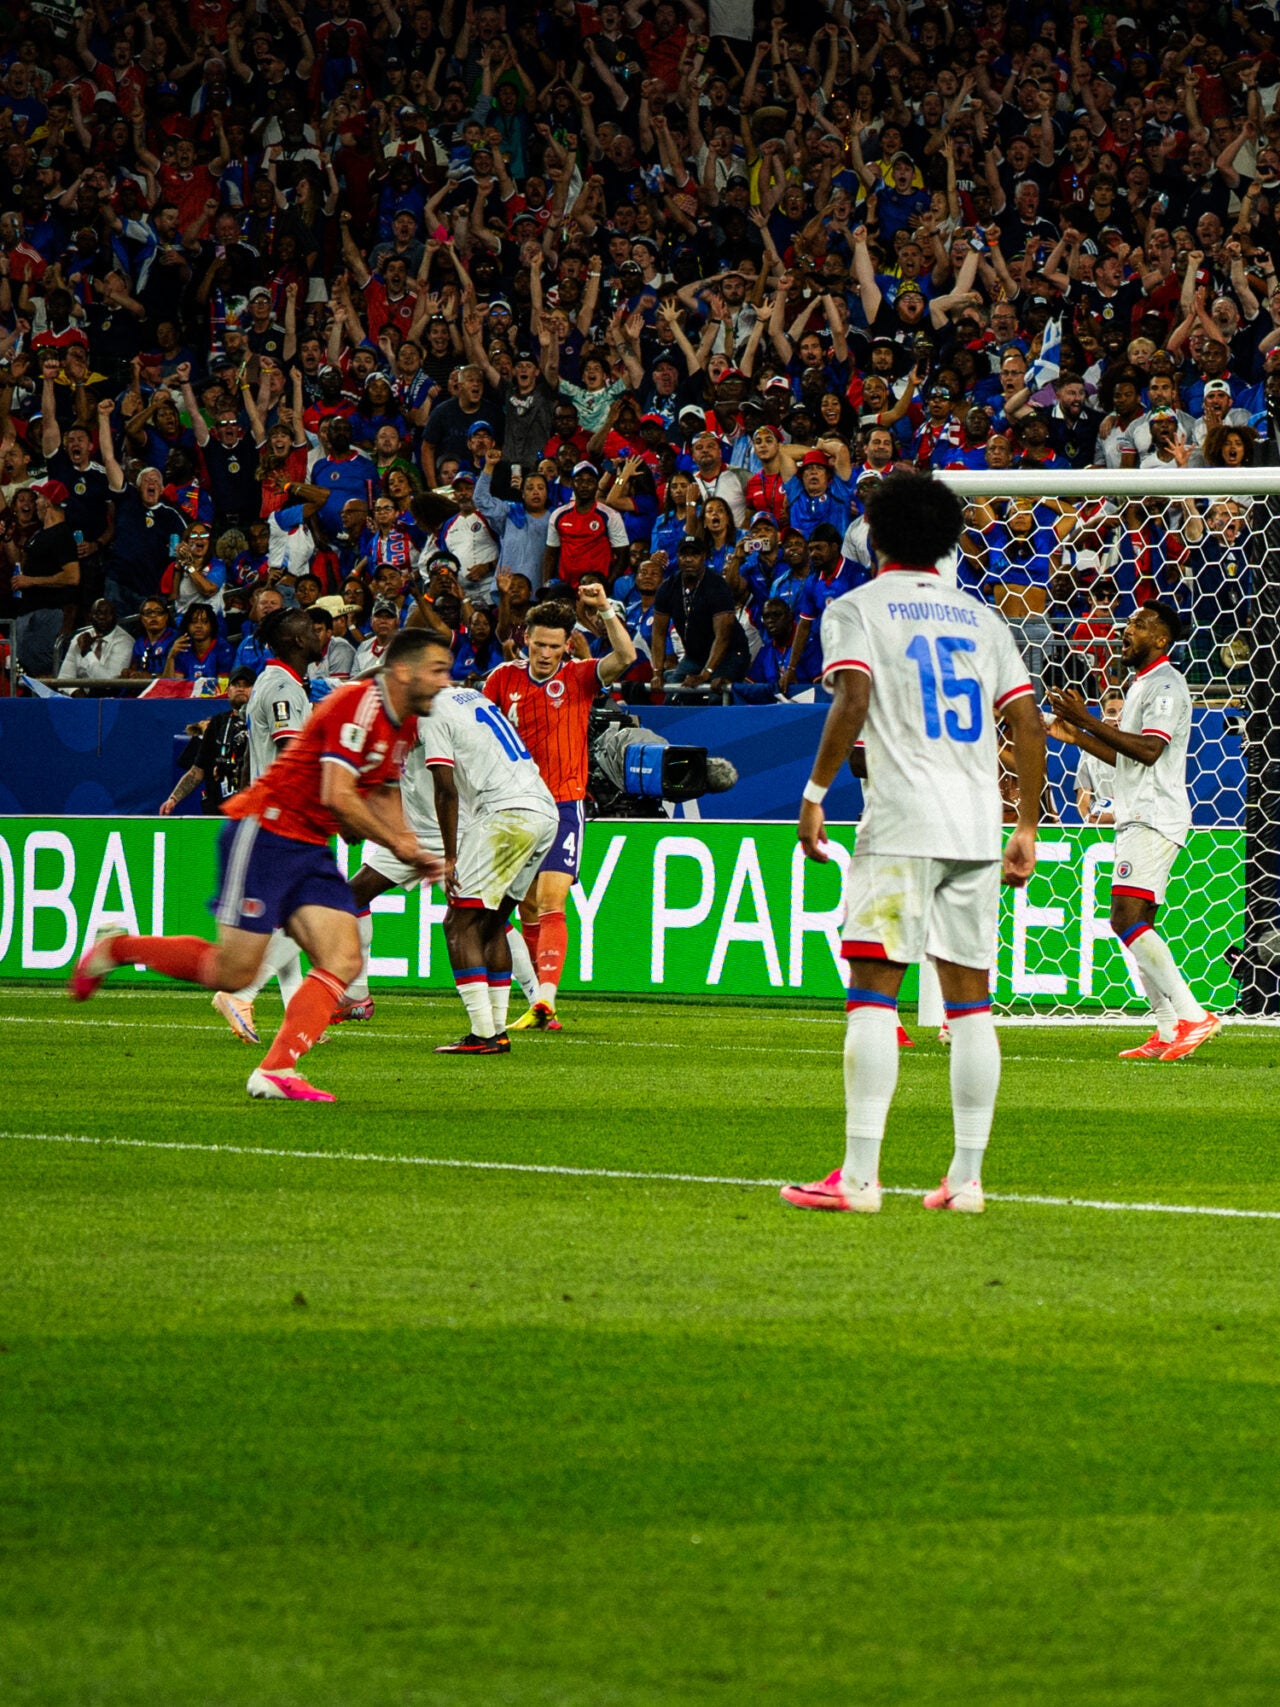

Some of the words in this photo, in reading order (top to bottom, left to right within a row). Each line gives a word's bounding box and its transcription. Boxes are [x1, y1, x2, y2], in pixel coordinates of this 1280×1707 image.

[888, 602, 980, 628] PROVIDENCE
[905, 635, 983, 743] 15
[475, 705, 532, 762] 10
[507, 702, 520, 728] 4
[562, 831, 577, 857] 4
[650, 836, 1147, 996] PARER
